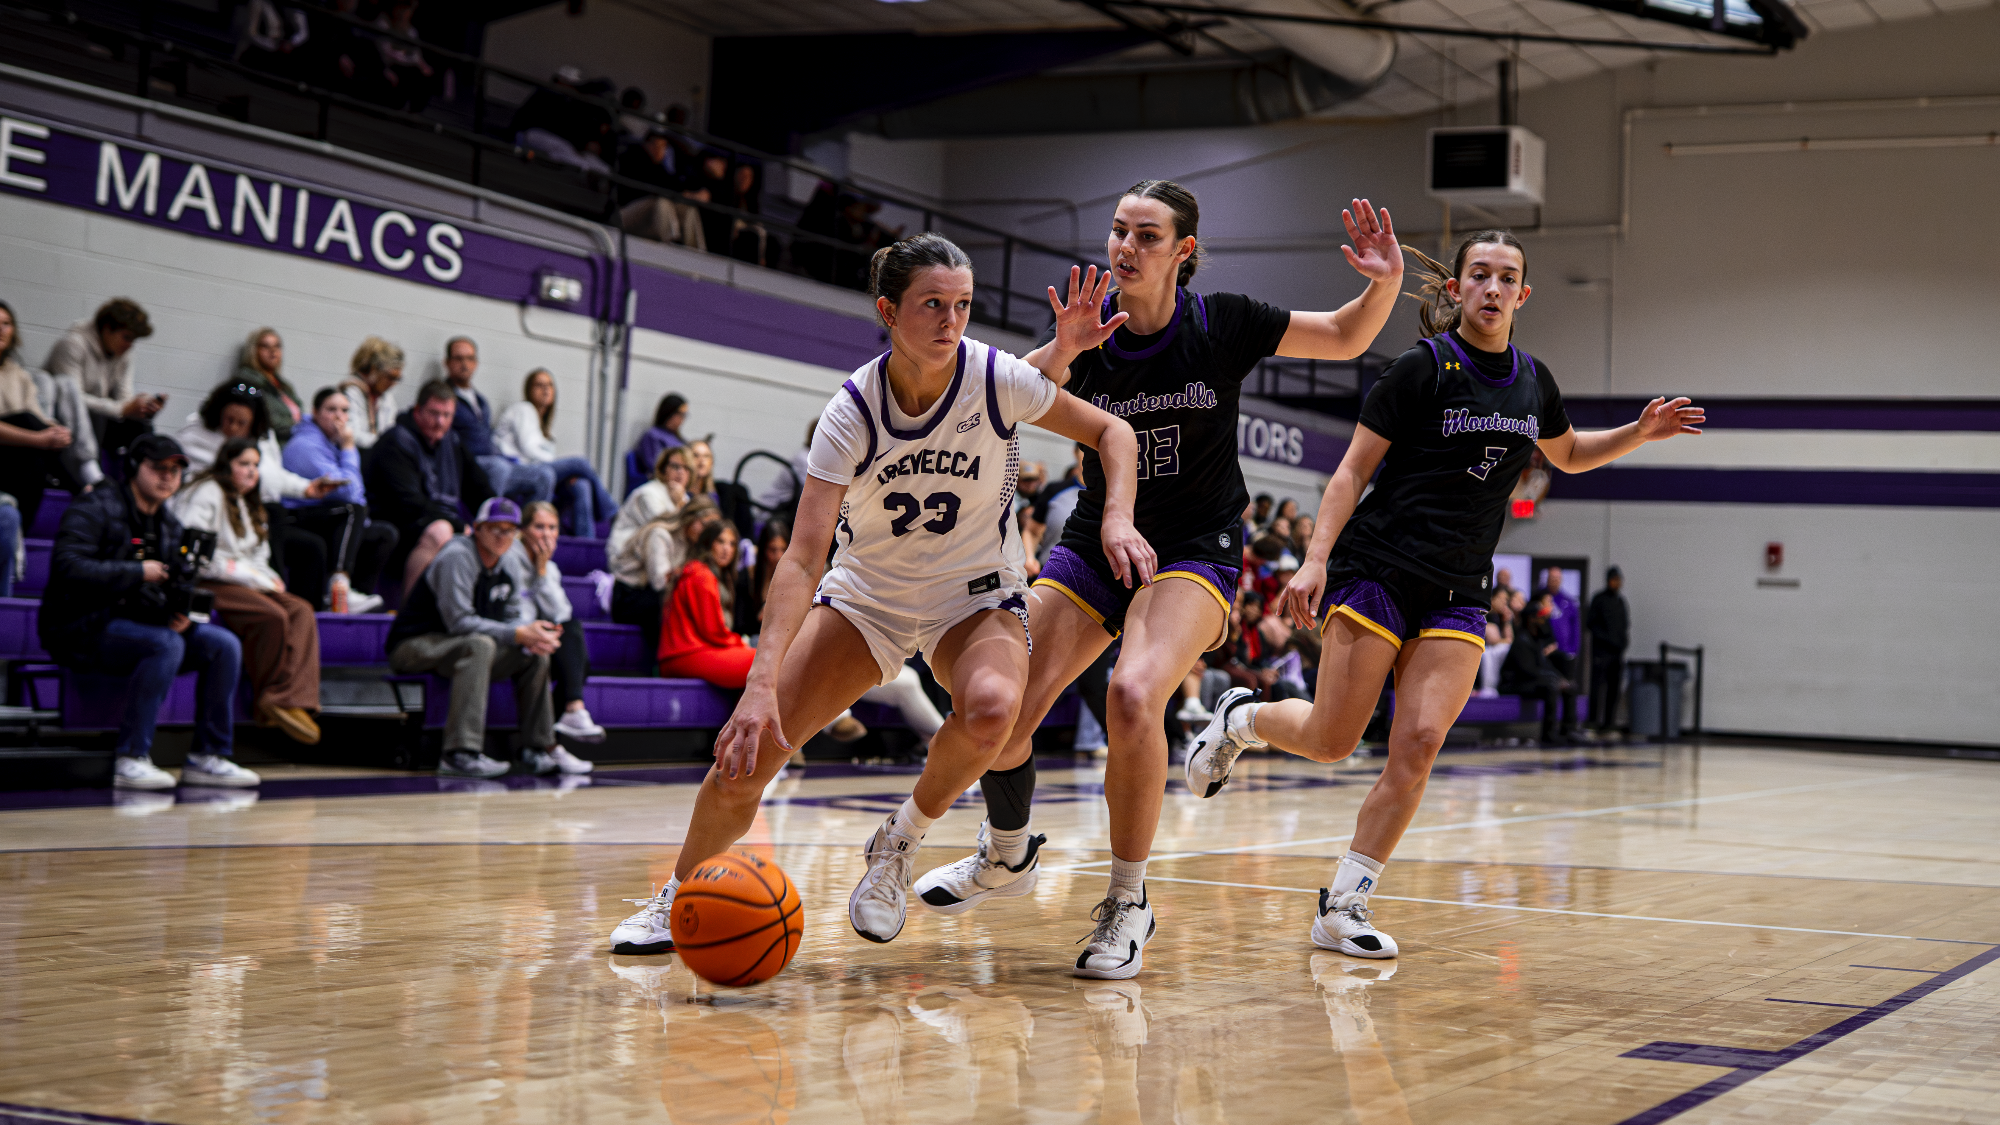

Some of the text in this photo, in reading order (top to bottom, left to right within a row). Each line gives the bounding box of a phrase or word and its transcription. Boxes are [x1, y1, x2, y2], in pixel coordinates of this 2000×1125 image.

[0, 116, 464, 282] E MANIACS
[883, 492, 962, 537] 23
